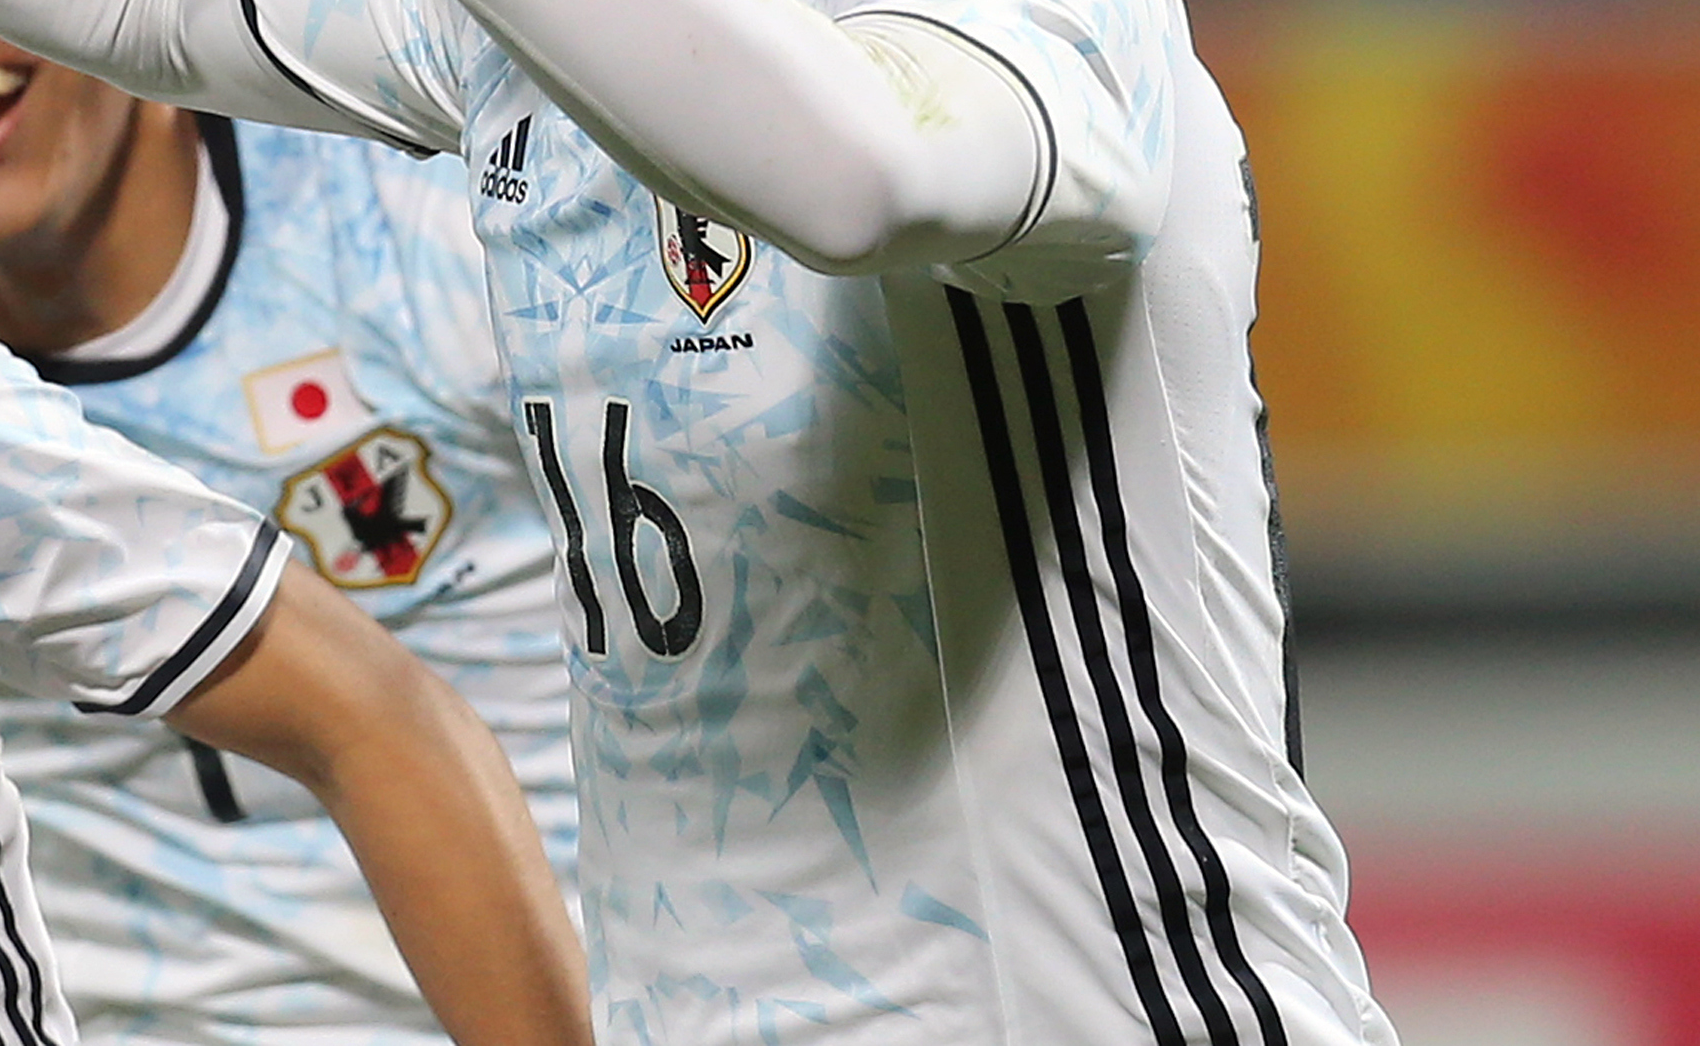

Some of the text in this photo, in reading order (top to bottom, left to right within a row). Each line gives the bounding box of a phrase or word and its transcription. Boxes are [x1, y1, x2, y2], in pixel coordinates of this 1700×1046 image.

[480, 168, 529, 204] adidas
[670, 333, 753, 354] JAPAN
[301, 442, 401, 512] JFA
[522, 399, 703, 658] 16
